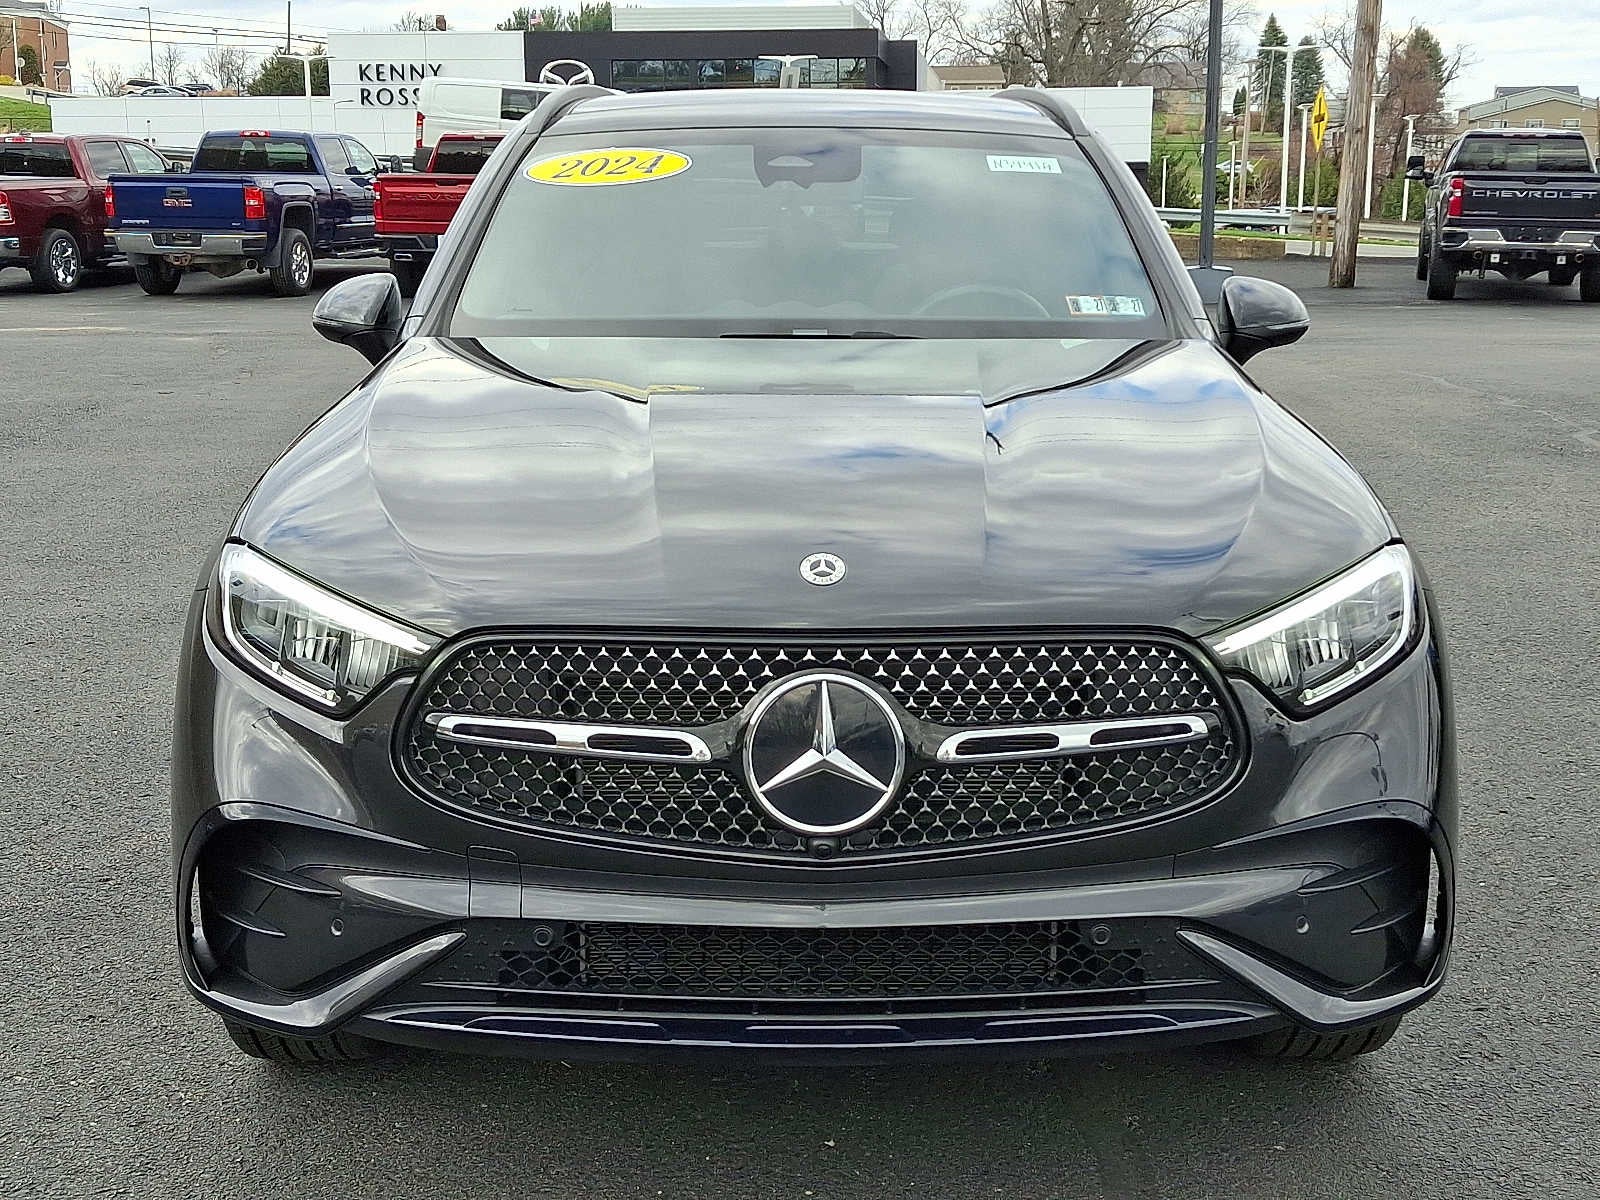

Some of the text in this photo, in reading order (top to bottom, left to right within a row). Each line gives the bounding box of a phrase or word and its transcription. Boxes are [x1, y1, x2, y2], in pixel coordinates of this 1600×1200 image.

[358, 63, 442, 81] KENNY
[551, 154, 665, 179] 2024
[1471, 189, 1598, 200] CHEVROLET
[162, 198, 193, 207] GMC
